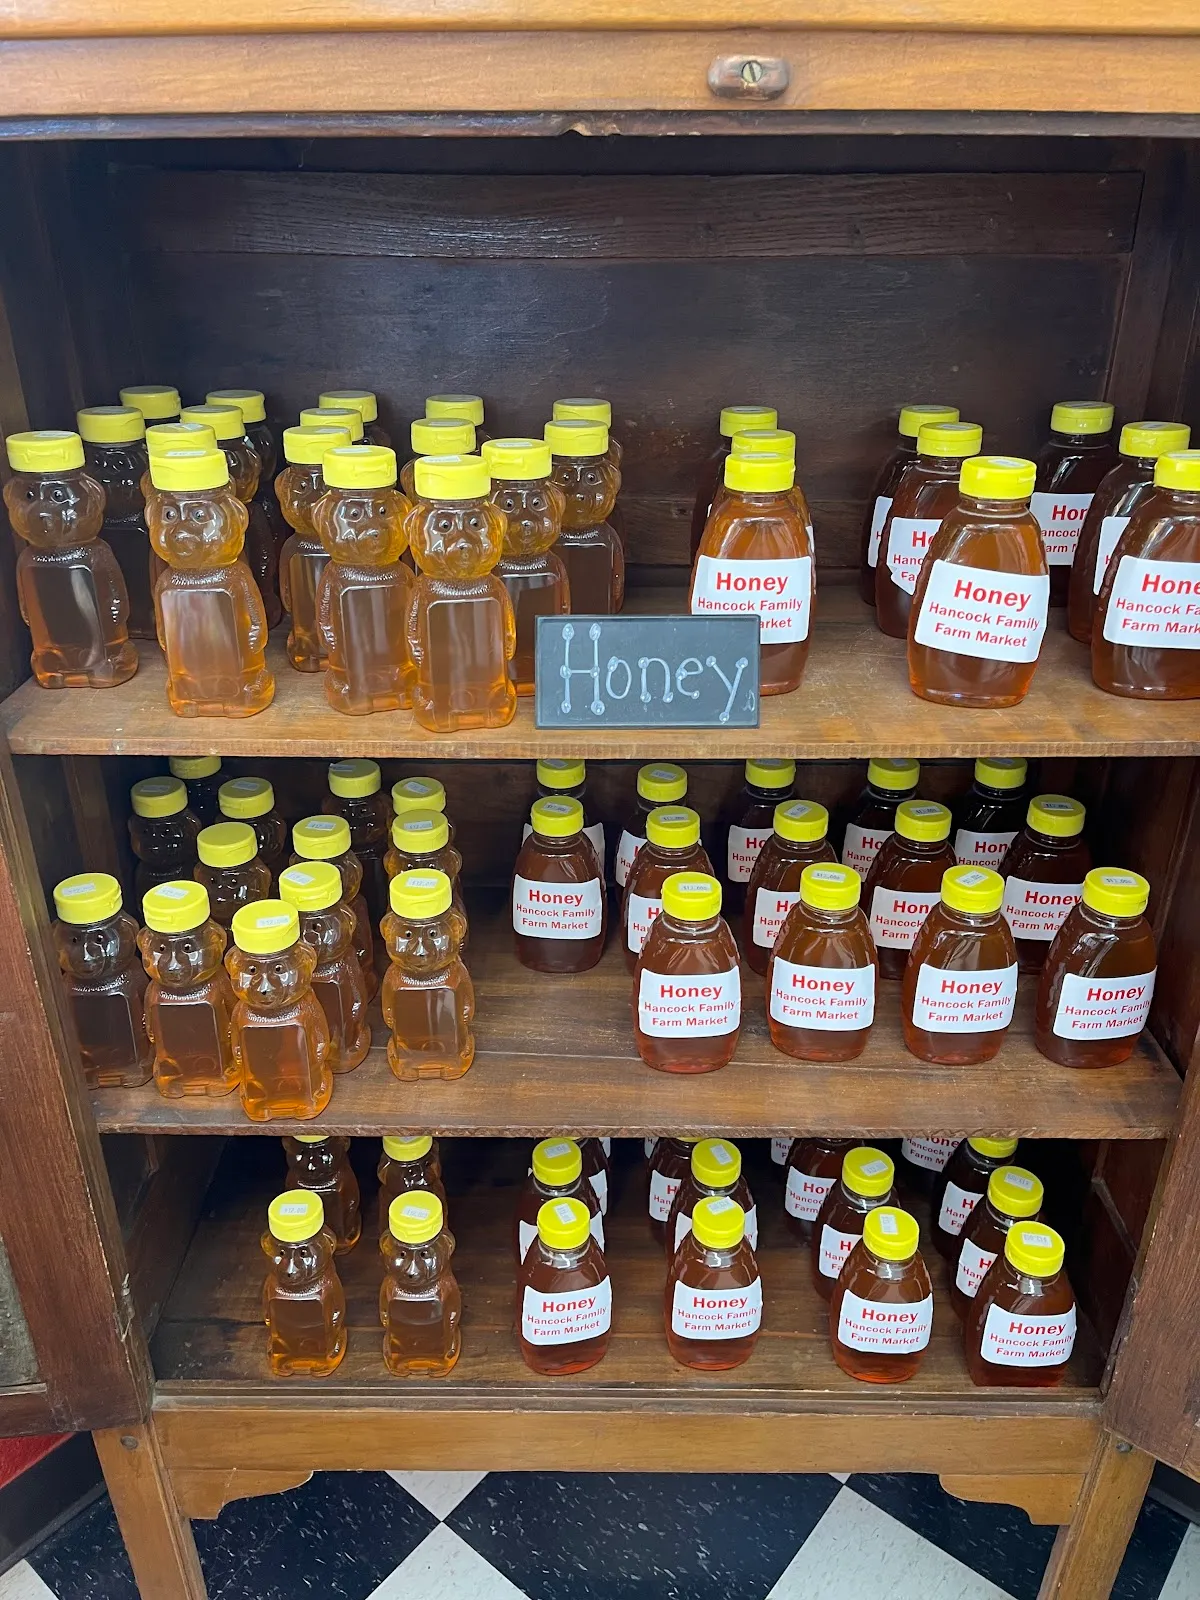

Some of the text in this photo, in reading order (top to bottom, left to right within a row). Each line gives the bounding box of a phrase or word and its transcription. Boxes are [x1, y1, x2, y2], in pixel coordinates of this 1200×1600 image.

[1052, 504, 1088, 521] Hon
[1041, 528, 1080, 538] ancoc
[1046, 544, 1068, 553] arm
[893, 554, 925, 565] Hanc
[716, 572, 788, 595] Honey
[901, 571, 916, 582] Fa
[1141, 573, 1200, 596] Hone
[954, 579, 1032, 612] Honey
[697, 596, 803, 612] Hancock Family
[1115, 597, 1181, 615] Hancock
[760, 617, 792, 629] arket
[929, 601, 1040, 632] Hancock Family
[1122, 618, 1200, 634] Farm Mark
[935, 622, 1028, 647] Farm Market
[559, 622, 749, 723] Honey
[974, 841, 1008, 853] Hon
[732, 852, 757, 862] Hanc
[847, 850, 874, 862] Hanc
[958, 856, 1000, 866] Hancoc
[739, 865, 751, 873] Fa
[529, 889, 584, 907] Honey
[516, 903, 596, 918] Hancock Family
[893, 900, 929, 914] Hon
[1006, 904, 1055, 919] Hancock
[522, 917, 589, 930] Farm Market
[1011, 919, 1040, 930] Farm
[881, 929, 910, 939] Farm
[792, 973, 855, 995] Honey
[941, 979, 1003, 996] Honey
[660, 984, 723, 1000] Honey
[776, 988, 867, 1007] Hancock Family
[1087, 984, 1146, 1001] Honey
[644, 1000, 736, 1013] Hancock Family
[921, 995, 1013, 1009] Hancock Family
[782, 1005, 859, 1020] Farm Market
[928, 1010, 1003, 1022] Farm Market
[1065, 1005, 1117, 1016] Hancock
[652, 1015, 728, 1027] Farm Market
[1071, 1014, 1143, 1029] Farm Market
[926, 1137, 960, 1149] one
[910, 1149, 933, 1162] Farm
[542, 1296, 597, 1313] Honey
[693, 1296, 748, 1309] Honey
[527, 1307, 607, 1325] Hancock Family
[677, 1306, 758, 1320] Hancock Family
[862, 1307, 919, 1325] Honey
[533, 1320, 600, 1336] Farm Market
[684, 1320, 752, 1331] Farm Market
[844, 1317, 928, 1334] Hancock Family
[1009, 1321, 1067, 1336] Honey
[851, 1332, 920, 1345] Farm Market
[989, 1332, 1039, 1347] Hancock
[996, 1347, 1066, 1358] Farm Market
